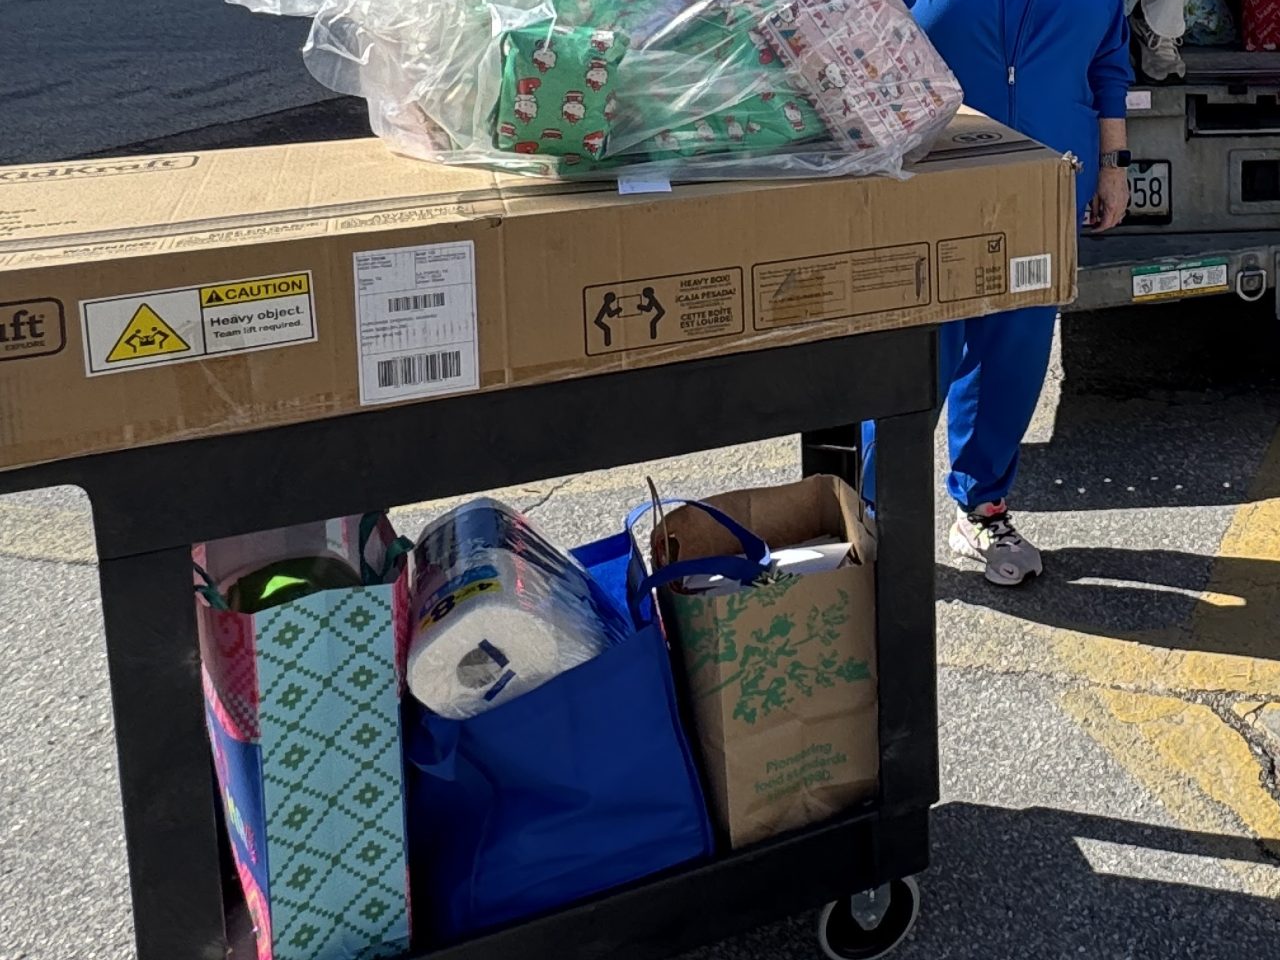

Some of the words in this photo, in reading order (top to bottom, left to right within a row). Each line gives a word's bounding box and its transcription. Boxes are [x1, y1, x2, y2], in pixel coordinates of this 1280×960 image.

[225, 280, 302, 300] CAUTION
[680, 277, 709, 288] HEAVY
[702, 288, 736, 299] PESADA!
[210, 314, 254, 327] Heavy
[257, 306, 304, 320] object.
[680, 311, 707, 321] CETTE
[213, 329, 241, 338] Team
[243, 326, 257, 334] lift
[766, 743, 832, 773] Pioneering
[754, 773, 785, 793] food
[786, 752, 847, 778] standards
